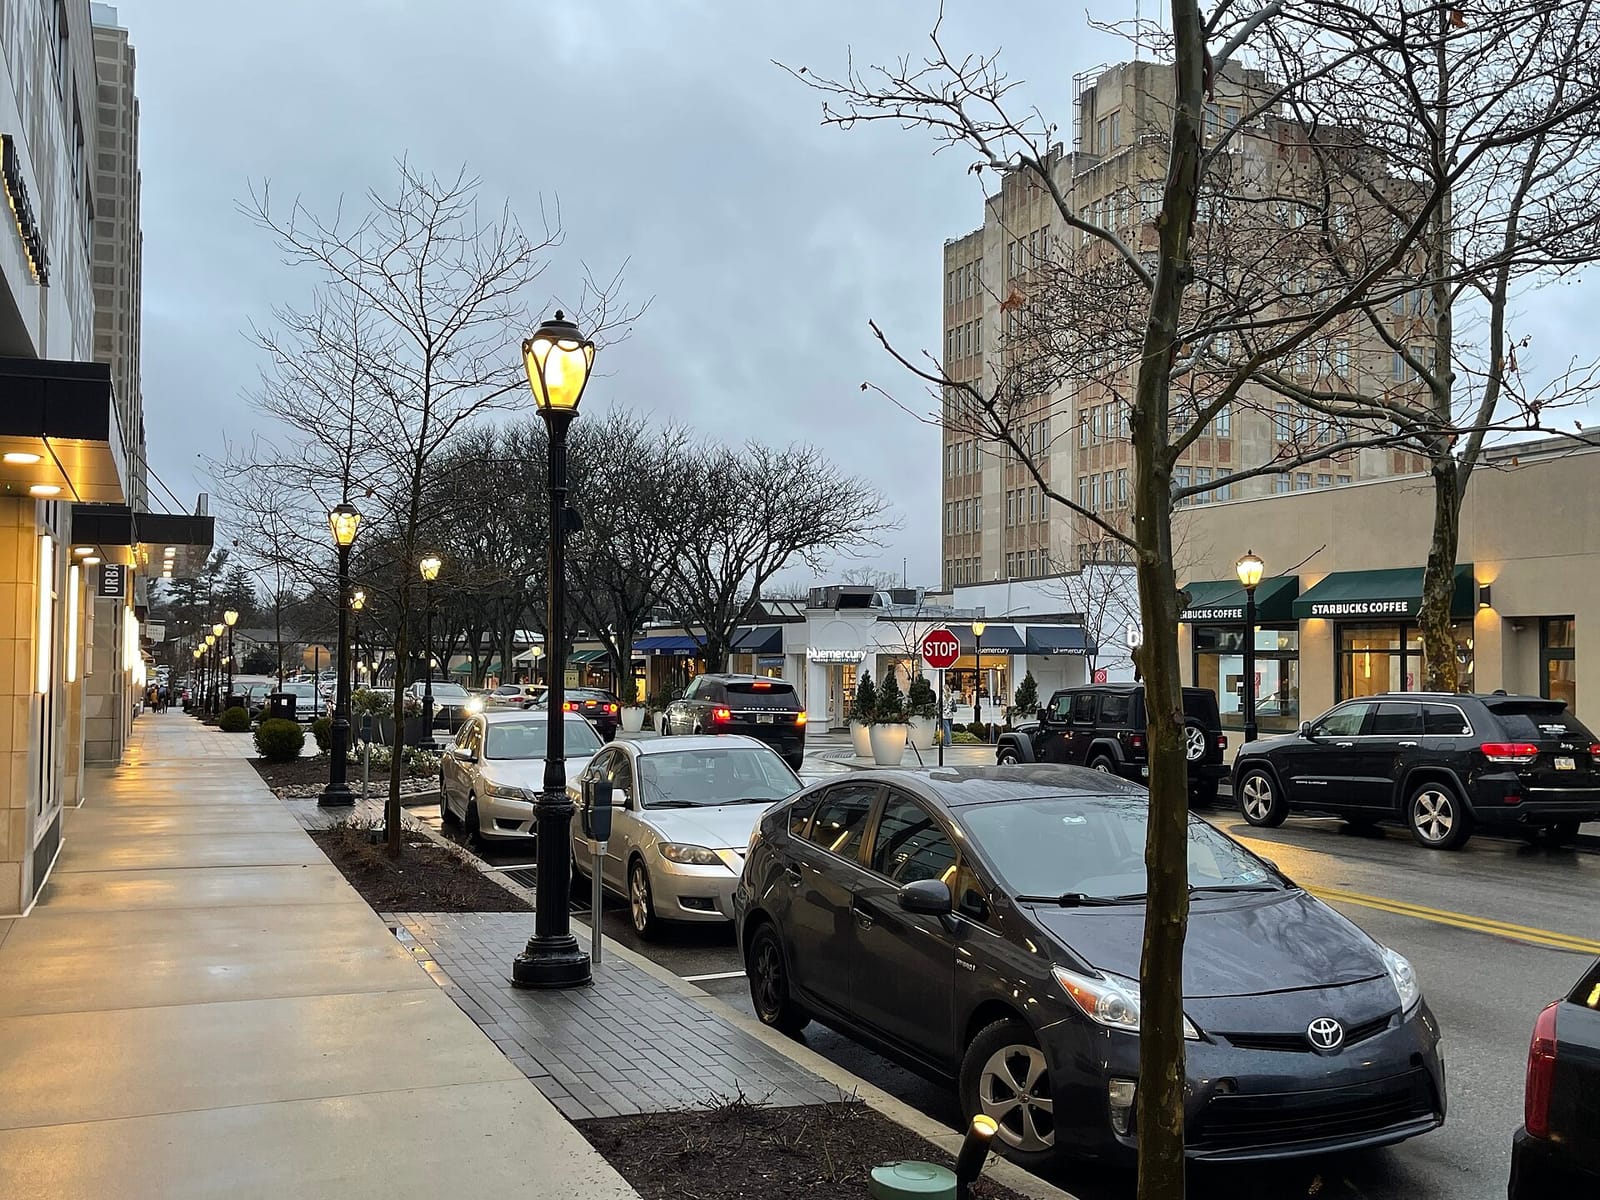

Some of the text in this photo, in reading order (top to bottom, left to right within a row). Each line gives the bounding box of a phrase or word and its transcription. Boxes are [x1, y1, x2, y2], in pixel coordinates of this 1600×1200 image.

[1213, 608, 1243, 618] COFFEE
[1311, 601, 1408, 615] STARBUCKS COFFEE
[806, 647, 867, 661] bluemercury
[924, 641, 958, 657] STOP
[976, 646, 1010, 655] uemercury
